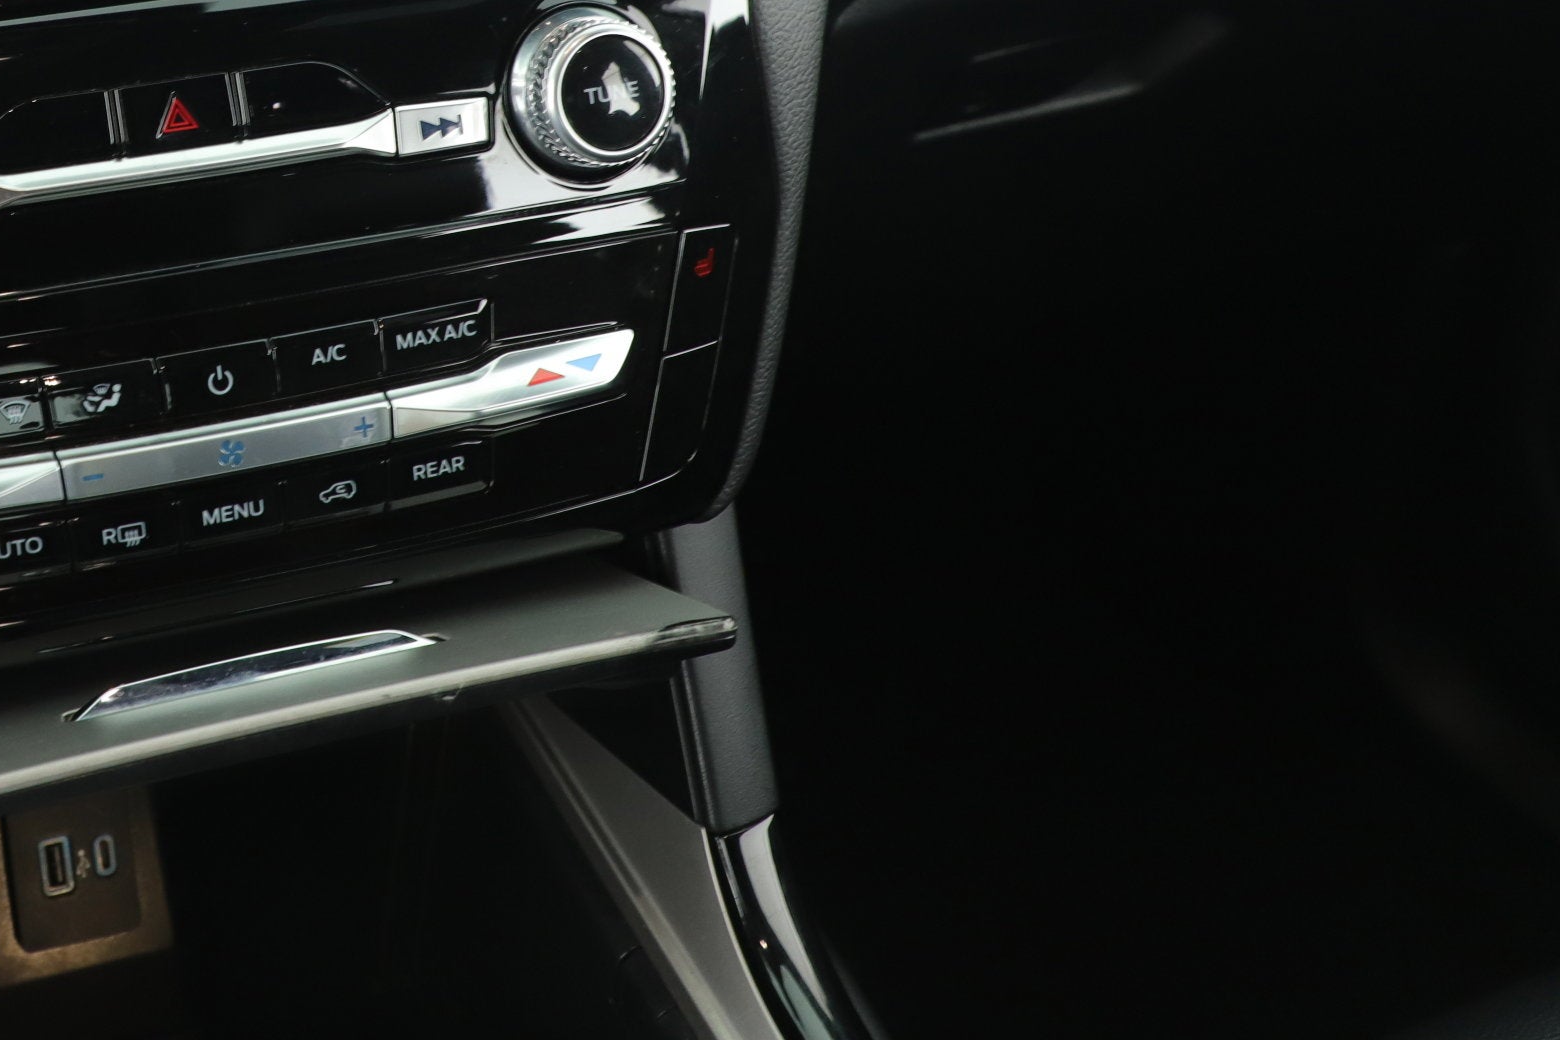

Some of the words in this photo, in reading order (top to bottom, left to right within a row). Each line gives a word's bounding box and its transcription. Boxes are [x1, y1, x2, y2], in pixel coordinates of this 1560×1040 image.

[396, 327, 442, 351] MAX
[444, 319, 478, 341] A/C
[311, 343, 347, 366] A/C
[412, 455, 465, 481] REAR
[202, 498, 265, 527] MENU
[102, 527, 117, 546] R
